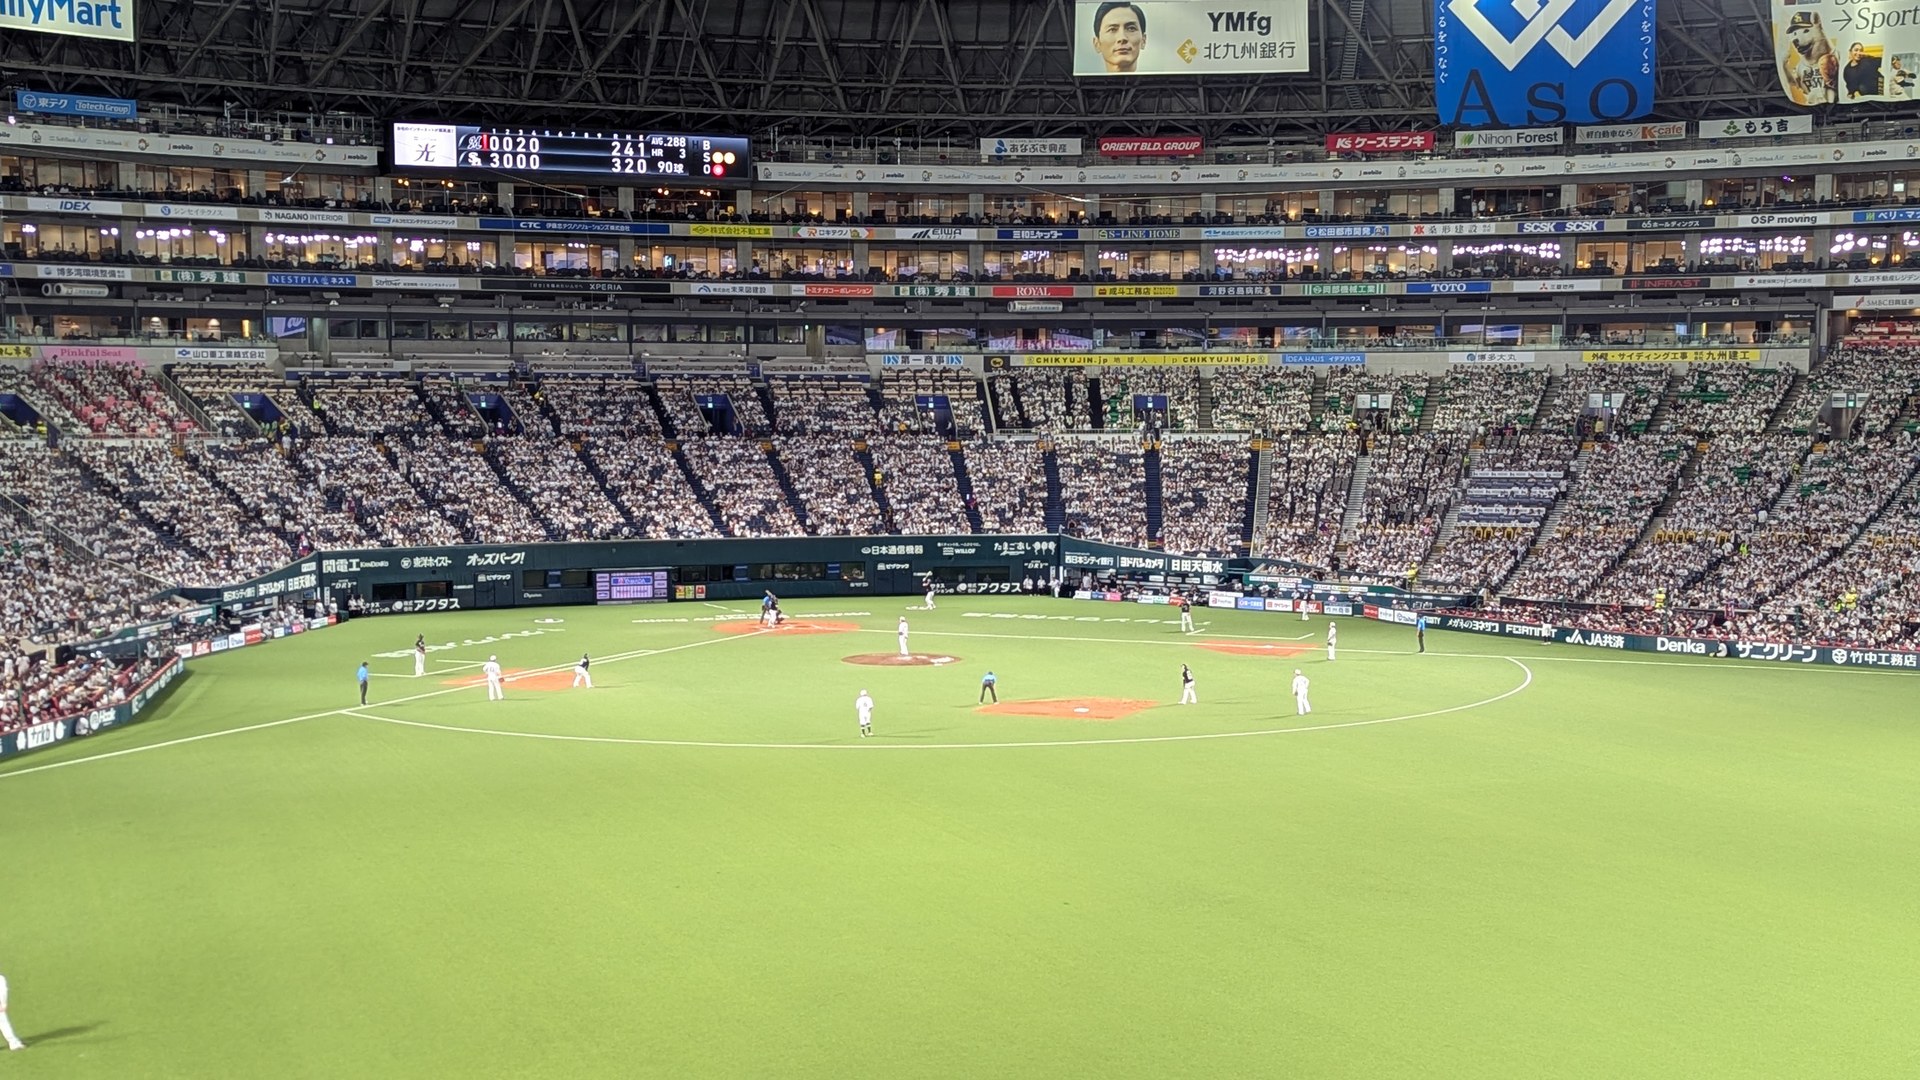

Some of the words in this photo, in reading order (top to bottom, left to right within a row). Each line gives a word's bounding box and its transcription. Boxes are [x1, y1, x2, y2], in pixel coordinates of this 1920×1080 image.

[1207, 11, 1271, 36] YMfg
[1639, 0, 1653, 75] ぐをつくる
[1204, 41, 1296, 60] 北九州銀行
[38, 97, 68, 109] 東テク
[105, 103, 129, 114] Group
[1744, 119, 1789, 134] もち吉
[1355, 135, 1425, 148] ケーズデンキ
[1477, 133, 1512, 145] Nihon
[1516, 131, 1558, 144] Forest
[489, 136, 499, 150] 0
[503, 136, 513, 151] 0
[516, 137, 526, 152] 2
[529, 137, 539, 152] 0
[611, 141, 620, 156] 2
[624, 142, 634, 156] 4
[638, 142, 645, 157] 1
[702, 140, 711, 151] B
[1101, 142, 1140, 151] ORIENT
[1140, 142, 1161, 151] BLD.
[1163, 141, 1200, 150] GROUP
[651, 148, 663, 157] HR
[679, 148, 686, 159] 3
[702, 152, 711, 163] S
[490, 152, 500, 168] 3
[503, 153, 512, 168] 0
[516, 153, 526, 169] 0
[529, 154, 539, 170] 0
[611, 157, 621, 173] 3
[624, 158, 634, 173] 2
[637, 158, 647, 174] 0
[59, 201, 91, 211] IDEX
[173, 207, 223, 217] シンセイテクノス
[274, 211, 309, 221] NAGANO
[309, 213, 343, 222] INTERIOR
[519, 221, 541, 229] CTC
[1751, 215, 1775, 225] OSP
[1777, 214, 1817, 225] moving
[1523, 222, 1555, 232] SCSK
[1564, 220, 1598, 231] SCSK
[932, 228, 962, 236] EIWA
[1108, 229, 1146, 238] S-LINE
[1148, 229, 1180, 238] HOME
[271, 275, 319, 284] NESTPIA
[1644, 278, 1701, 288] INFRAST
[1862, 273, 1920, 282] 三井不動産レジデン
[590, 283, 622, 291] XPERIA
[1016, 287, 1051, 296] ROYAL
[1431, 283, 1466, 293] TOTO
[60, 347, 100, 357] Pinkful
[101, 349, 122, 357] Seat
[1477, 353, 1517, 361] 博多大丸
[1706, 350, 1750, 360] 九州建工
[1036, 356, 1108, 364] CHIKYUJIN.jp
[1182, 355, 1256, 364] CHIKYUJIN.jp
[466, 552, 525, 568] オッズパーク!
[1065, 556, 1114, 566] 西日本シティ銀行
[1120, 556, 1164, 569] ヨドバシカメラ
[1171, 558, 1223, 573] 日田天領水
[977, 582, 1022, 593] アクタス
[414, 598, 461, 611] アクタス
[1447, 619, 1499, 632] メガネのヨネザワ
[1585, 632, 1625, 649] JA共済
[1656, 637, 1705, 654] Denka
[1736, 641, 1817, 662] サニクリーン
[1850, 652, 1917, 667] 竹中工務店
